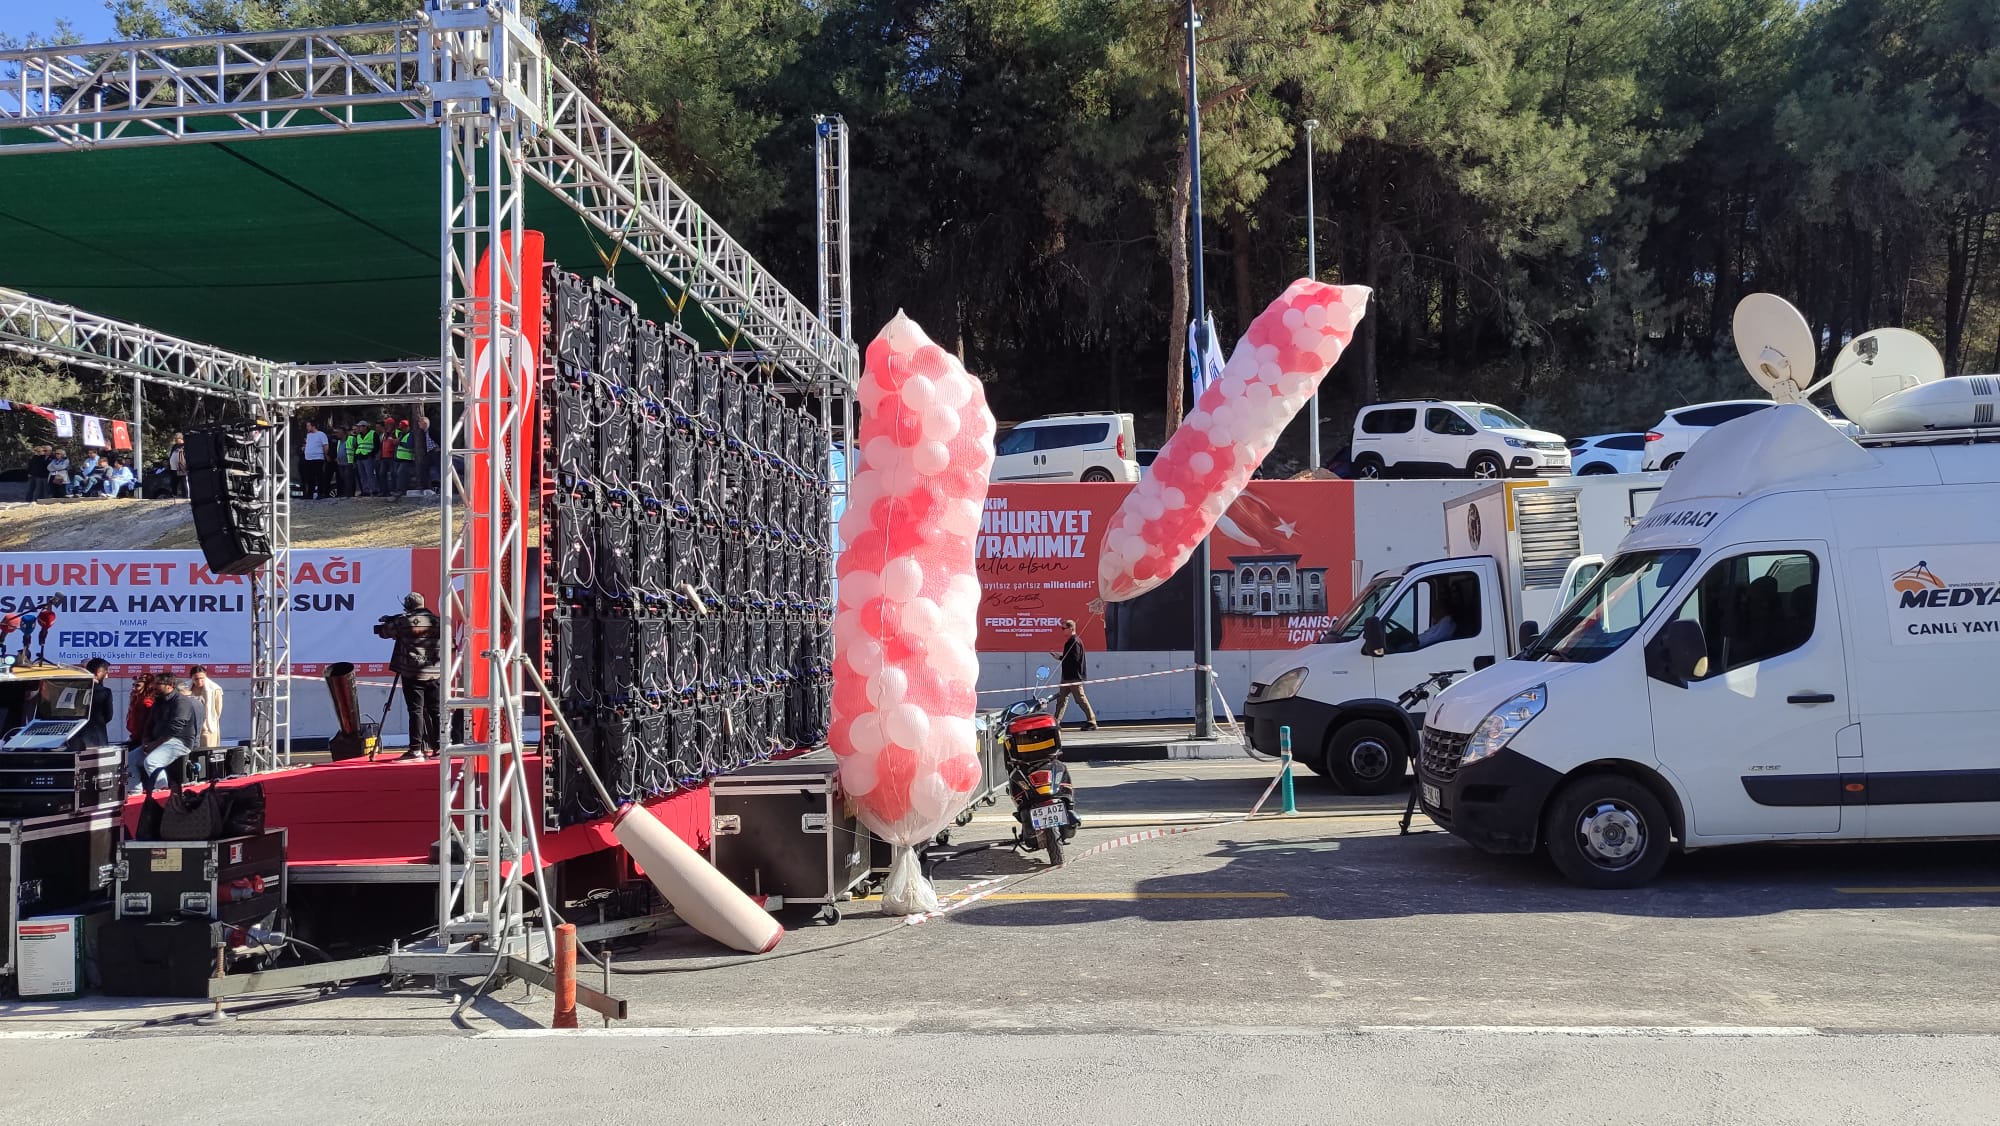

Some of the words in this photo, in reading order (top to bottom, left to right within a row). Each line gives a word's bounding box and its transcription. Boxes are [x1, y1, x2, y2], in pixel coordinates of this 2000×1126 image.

[1669, 511, 1718, 528] ARACI
[1018, 551, 1070, 576] olsun
[0, 558, 177, 587] HURİYET
[128, 595, 244, 613] HAYIRLI
[1018, 618, 1062, 627] ZEYREK
[123, 630, 209, 648] ZEYREK
[58, 651, 90, 659] Manisa
[91, 650, 137, 661] Büyükşehir
[139, 651, 175, 661] Belediye
[176, 650, 211, 661] Başkanı
[1043, 815, 1058, 824] 759
